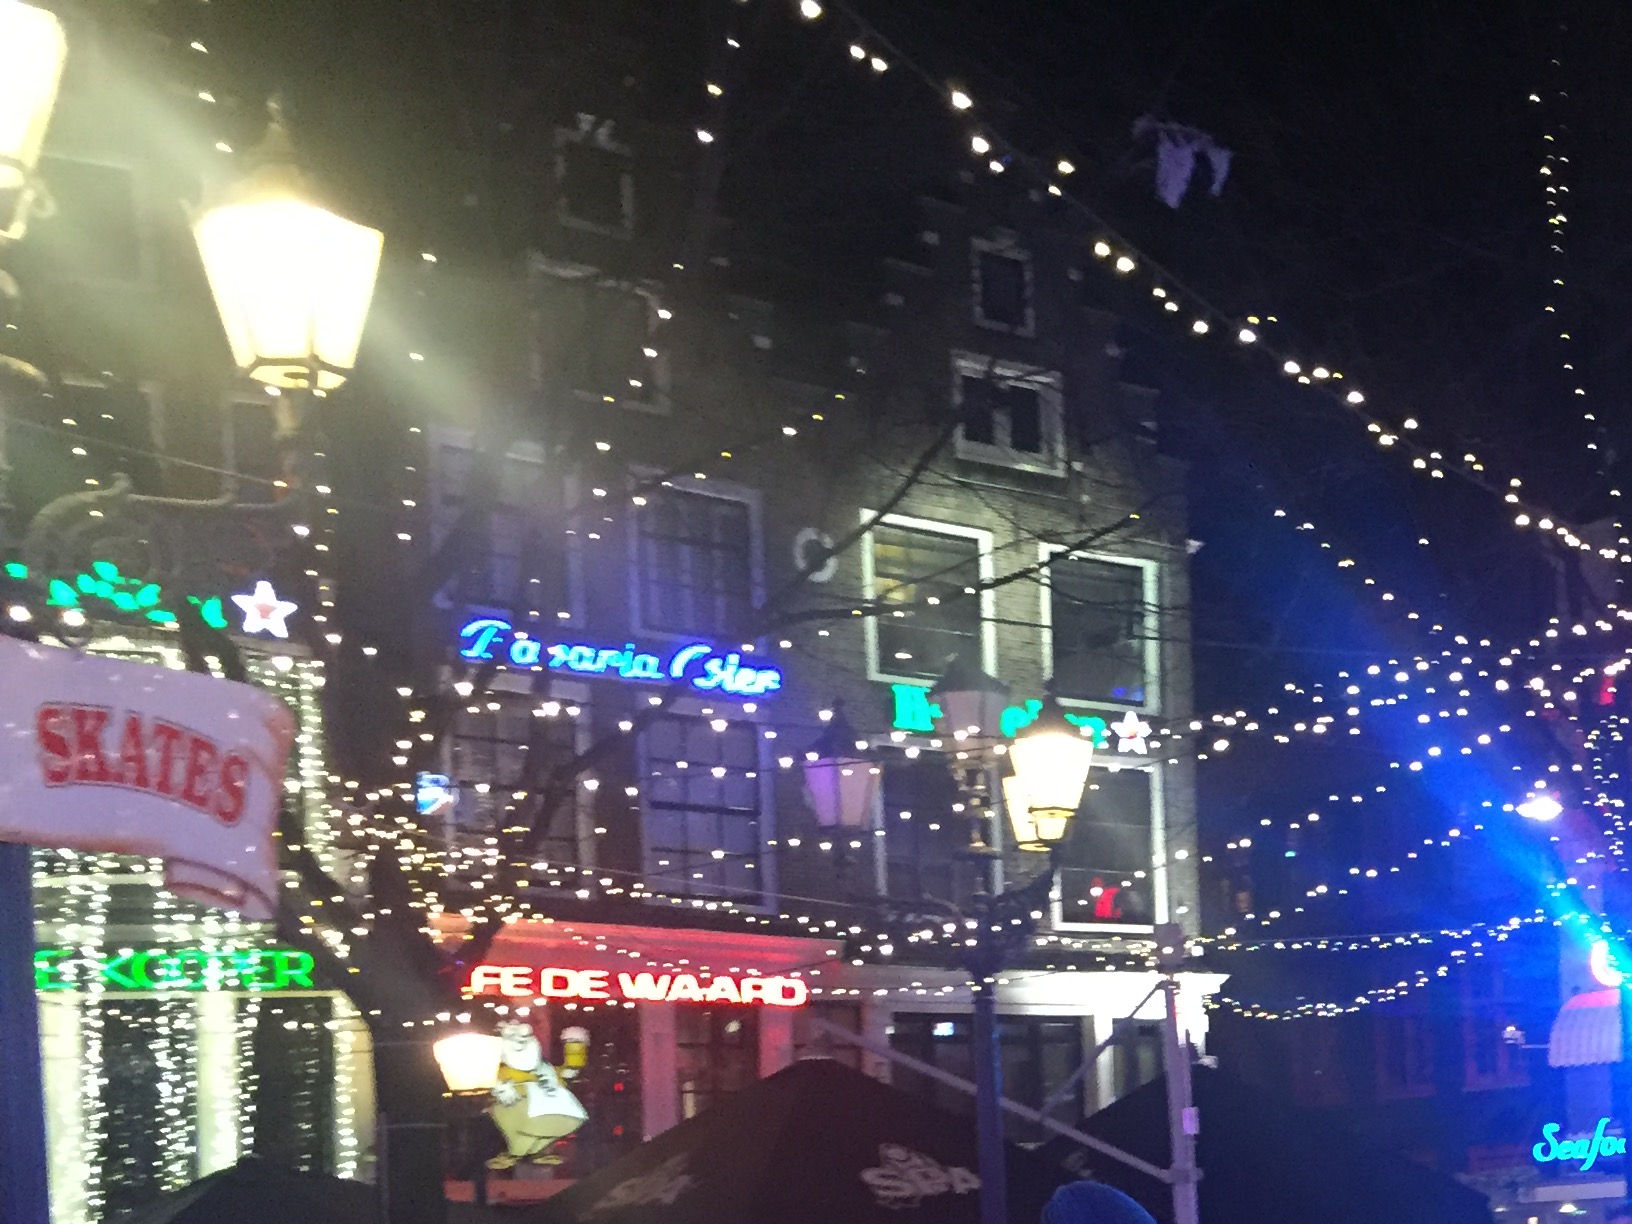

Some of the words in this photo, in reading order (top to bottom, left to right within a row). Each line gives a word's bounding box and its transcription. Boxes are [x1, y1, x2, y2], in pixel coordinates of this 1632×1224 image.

[36, 700, 250, 829] SKATES
[470, 964, 534, 997] FE
[540, 967, 611, 1000] DE
[617, 972, 808, 1006] WAARD
